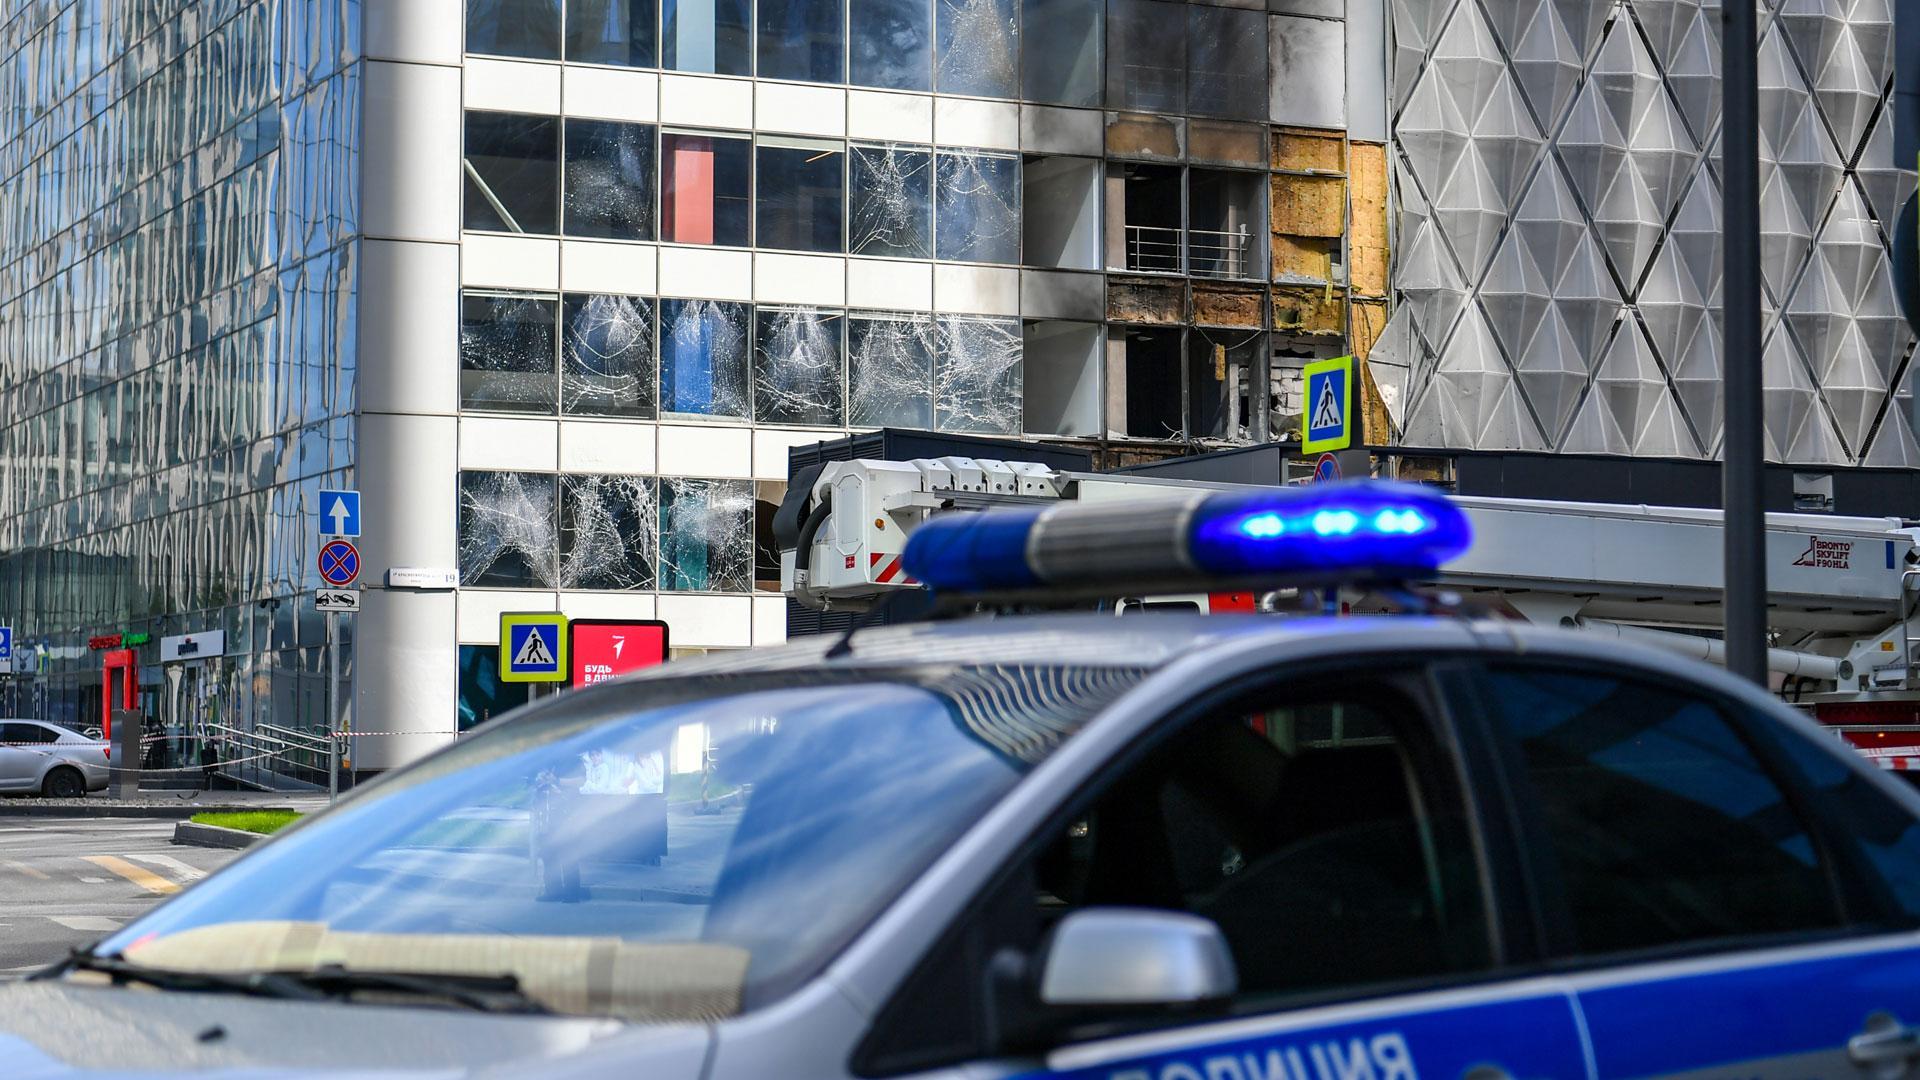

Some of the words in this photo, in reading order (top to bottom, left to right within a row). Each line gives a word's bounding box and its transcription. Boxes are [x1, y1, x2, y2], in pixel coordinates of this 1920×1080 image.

[1816, 541, 1850, 551] BRONTO
[1816, 550, 1849, 560] SKYLIFT
[445, 574, 456, 583] 19
[584, 664, 613, 674] БУДЬ
[584, 674, 592, 682] В
[1109, 1032, 1418, 1080] ИЦИЯ
